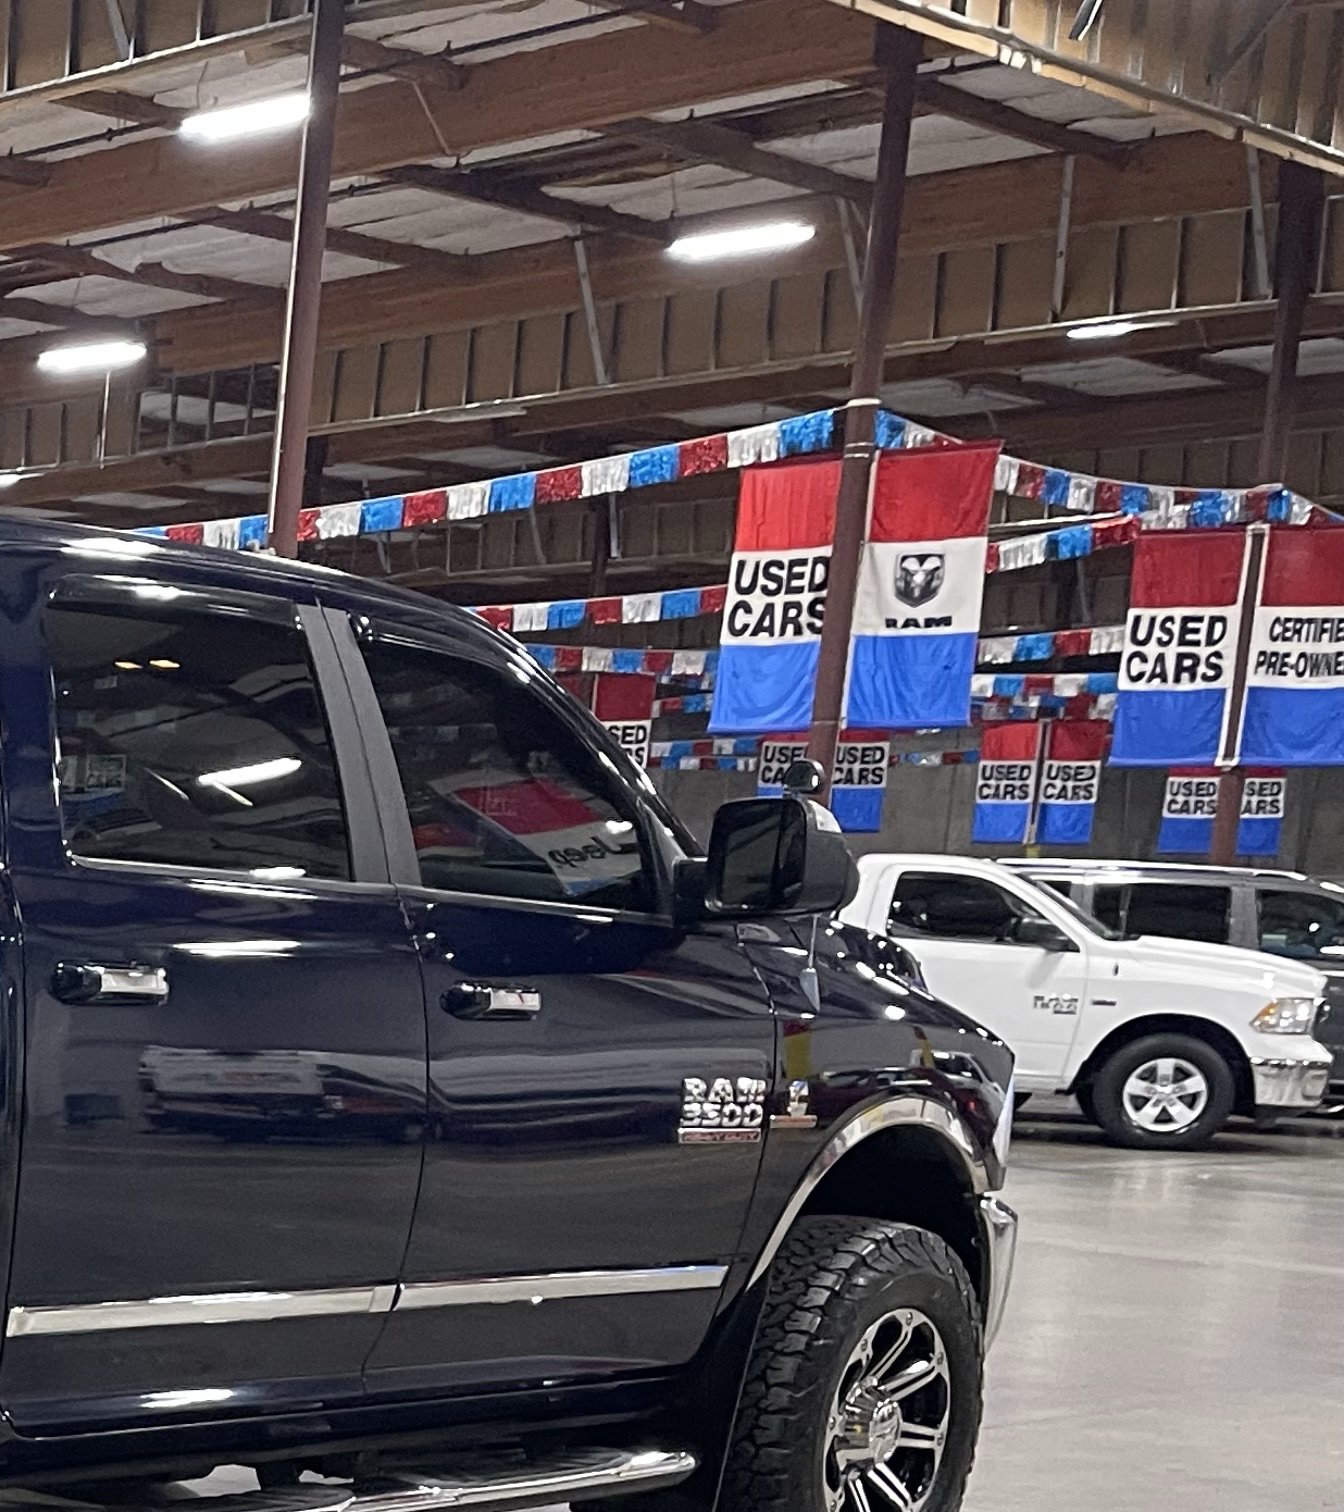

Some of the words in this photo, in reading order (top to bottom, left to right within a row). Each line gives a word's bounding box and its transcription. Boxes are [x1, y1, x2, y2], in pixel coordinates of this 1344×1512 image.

[734, 556, 830, 596] USED
[727, 597, 825, 637] CARS
[885, 616, 953, 629] RAM
[1130, 615, 1227, 647] USED
[1269, 616, 1344, 643] CERTIFIE
[1126, 651, 1224, 684] CARS
[1253, 651, 1344, 679] PRE-OWNE
[608, 725, 647, 745] SED
[764, 746, 807, 764] USE
[835, 746, 885, 765] USED
[762, 766, 786, 784] CA
[833, 767, 885, 785] CARS
[982, 764, 1032, 781] USED
[1046, 764, 1096, 782] USED
[978, 783, 1029, 800] CARS
[1043, 783, 1094, 800] CARS
[1169, 781, 1218, 797] USED
[1246, 781, 1282, 797] SED
[1167, 799, 1217, 815] CARS
[1241, 799, 1280, 815] ARS
[682, 1077, 767, 1103] RAM
[680, 1102, 764, 1128] 3500
